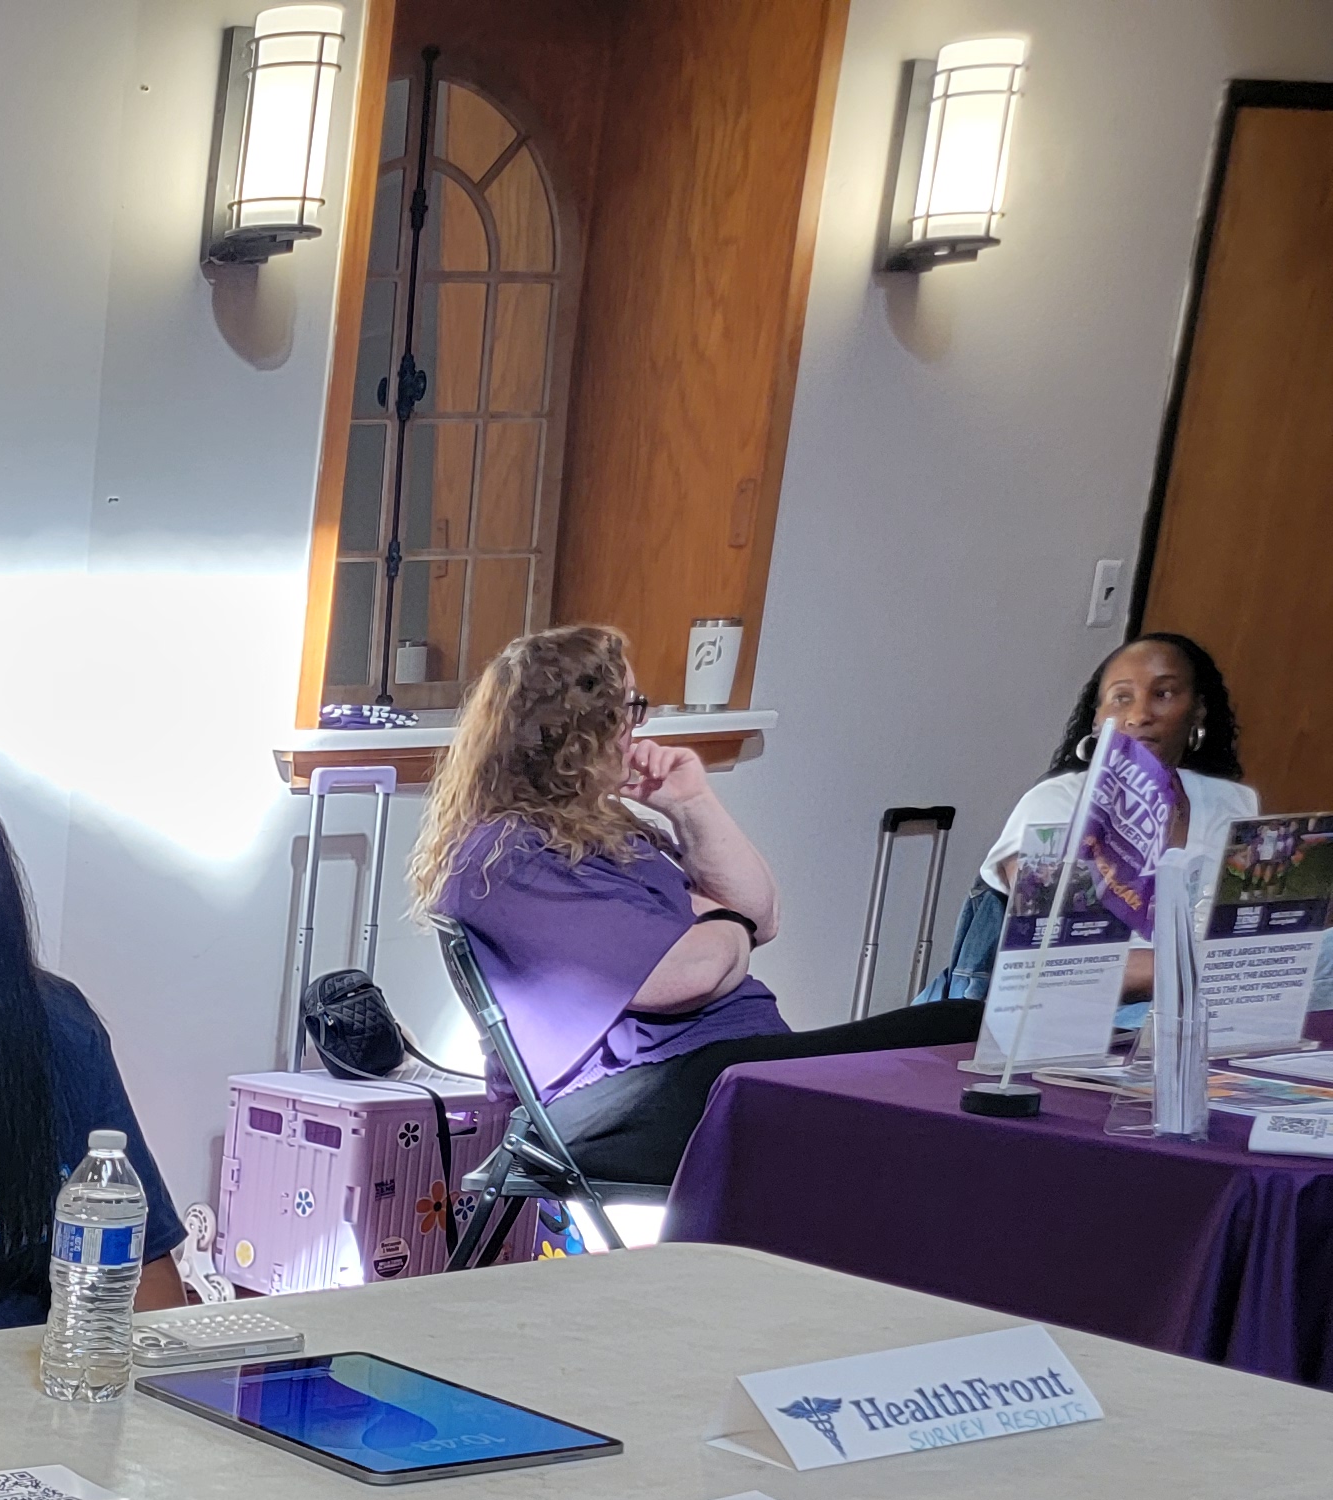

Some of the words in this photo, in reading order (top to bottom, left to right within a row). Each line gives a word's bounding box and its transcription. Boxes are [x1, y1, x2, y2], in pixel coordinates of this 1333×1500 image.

[1109, 749, 1158, 801] WALK
[1152, 792, 1168, 823] TO
[1218, 949, 1233, 957] THE
[1234, 946, 1266, 956] LARGEST
[1003, 962, 1023, 970] OVER
[1045, 958, 1082, 967] RESEARCH
[1083, 955, 1120, 964] PROJECTS
[1204, 961, 1233, 970] FUNDER
[1235, 960, 1247, 968] OF
[1243, 971, 1258, 979] THE
[1258, 968, 1307, 978] ASSOCIATION
[1222, 985, 1237, 993] THE
[1238, 983, 1260, 992] MOST
[849, 1366, 1074, 1431] HealthFront
[908, 1416, 986, 1451] SURVEY
[995, 1401, 1087, 1432] RESULTS
